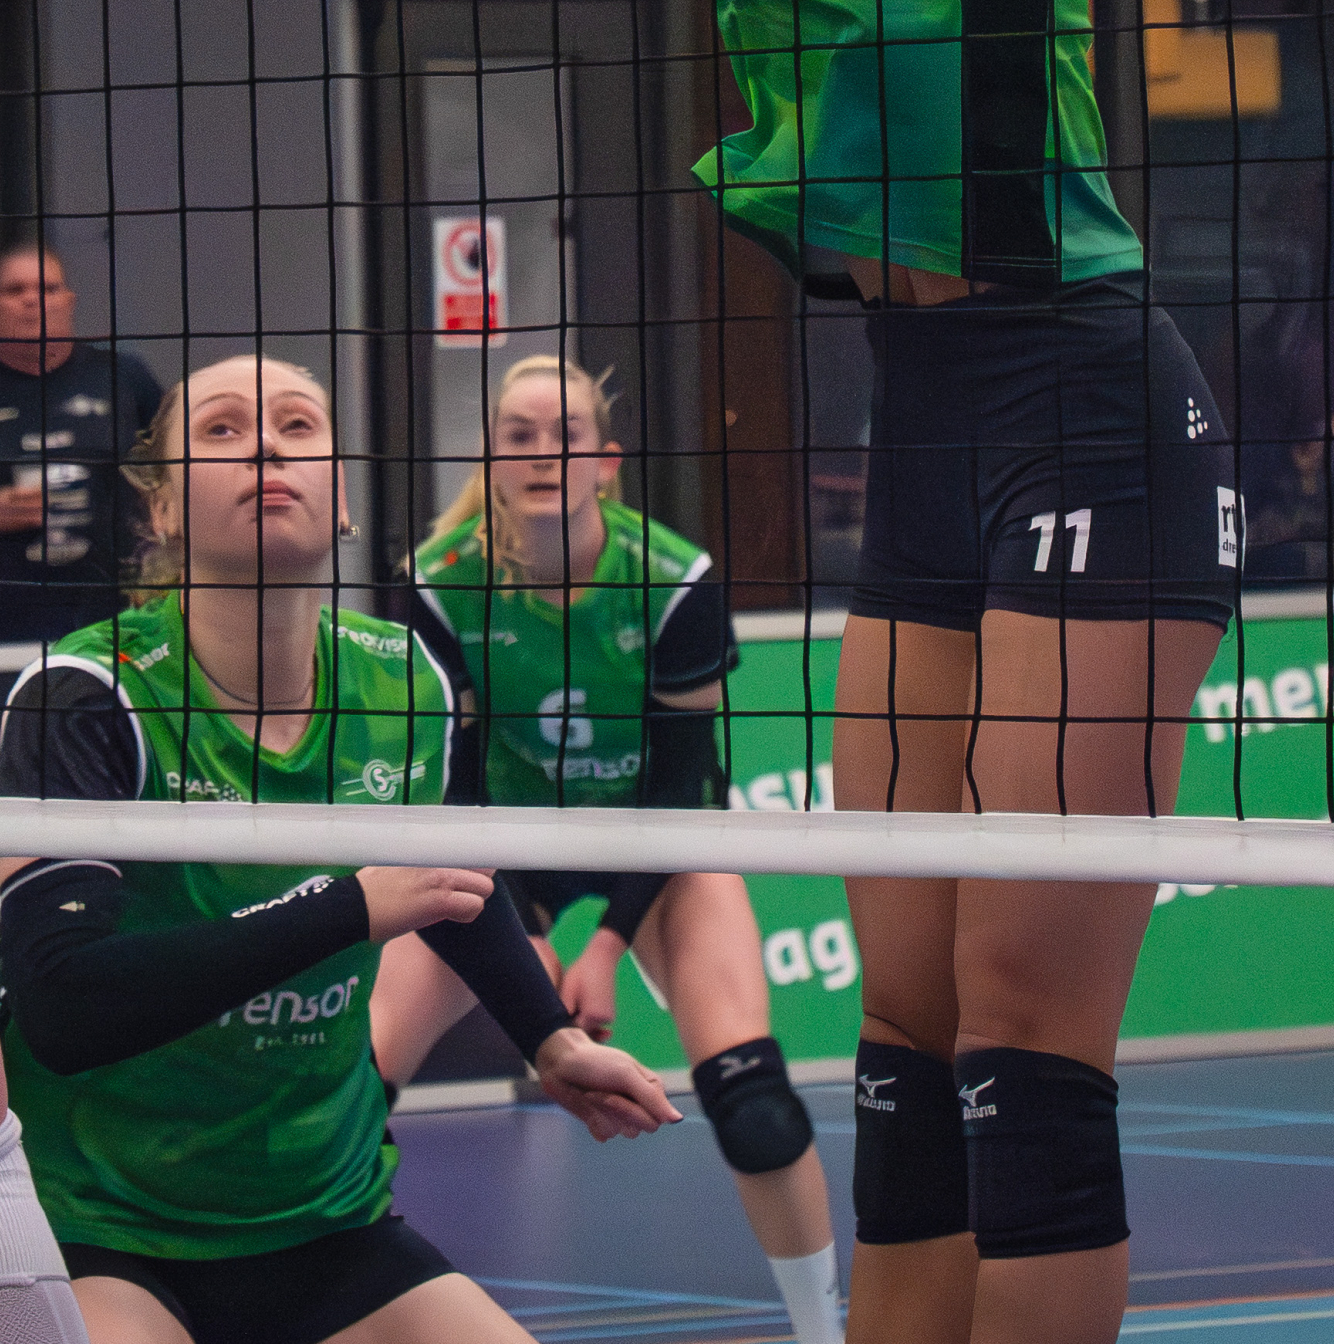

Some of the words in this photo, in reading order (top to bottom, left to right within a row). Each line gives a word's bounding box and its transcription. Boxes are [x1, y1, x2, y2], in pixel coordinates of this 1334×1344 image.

[1027, 508, 1092, 573] 11
[538, 687, 594, 749] 6
[764, 919, 859, 992] ag
